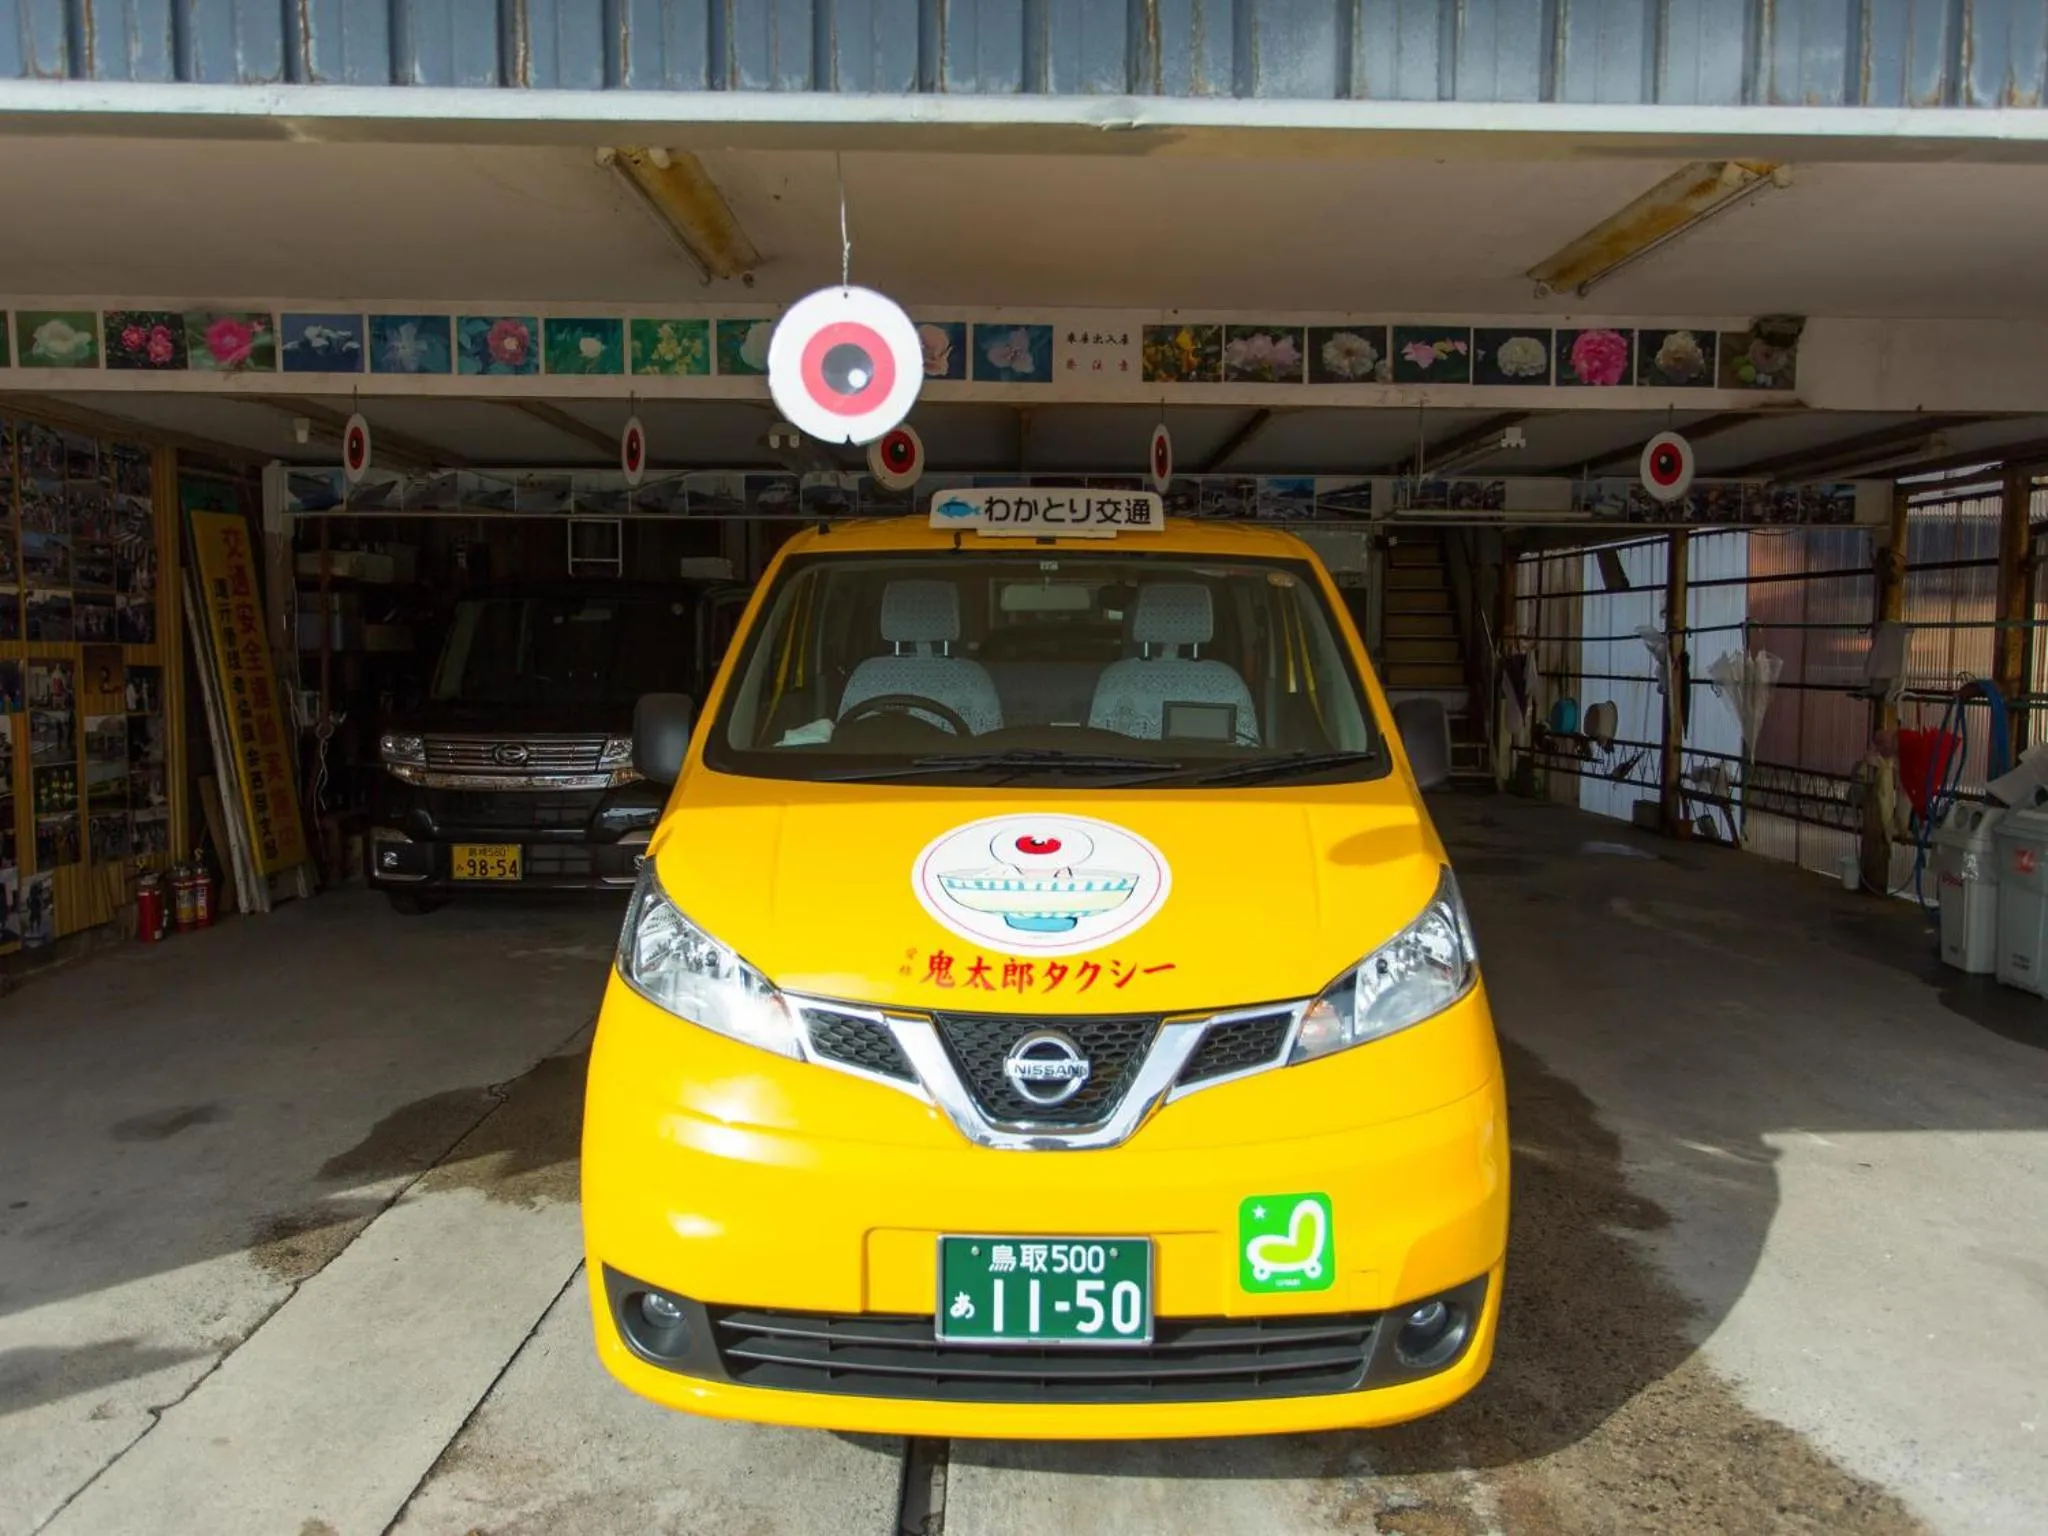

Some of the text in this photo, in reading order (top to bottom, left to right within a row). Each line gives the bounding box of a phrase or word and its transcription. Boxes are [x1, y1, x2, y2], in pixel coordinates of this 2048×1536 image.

[984, 496, 1151, 524] わかとり交通
[467, 859, 517, 877] 98-54
[920, 950, 1176, 993] 鬼太郎タクシー
[1014, 1064, 1080, 1075] NISSAN
[989, 1244, 1105, 1273] 鳥取500
[950, 1278, 1141, 1334] あ 11-50
